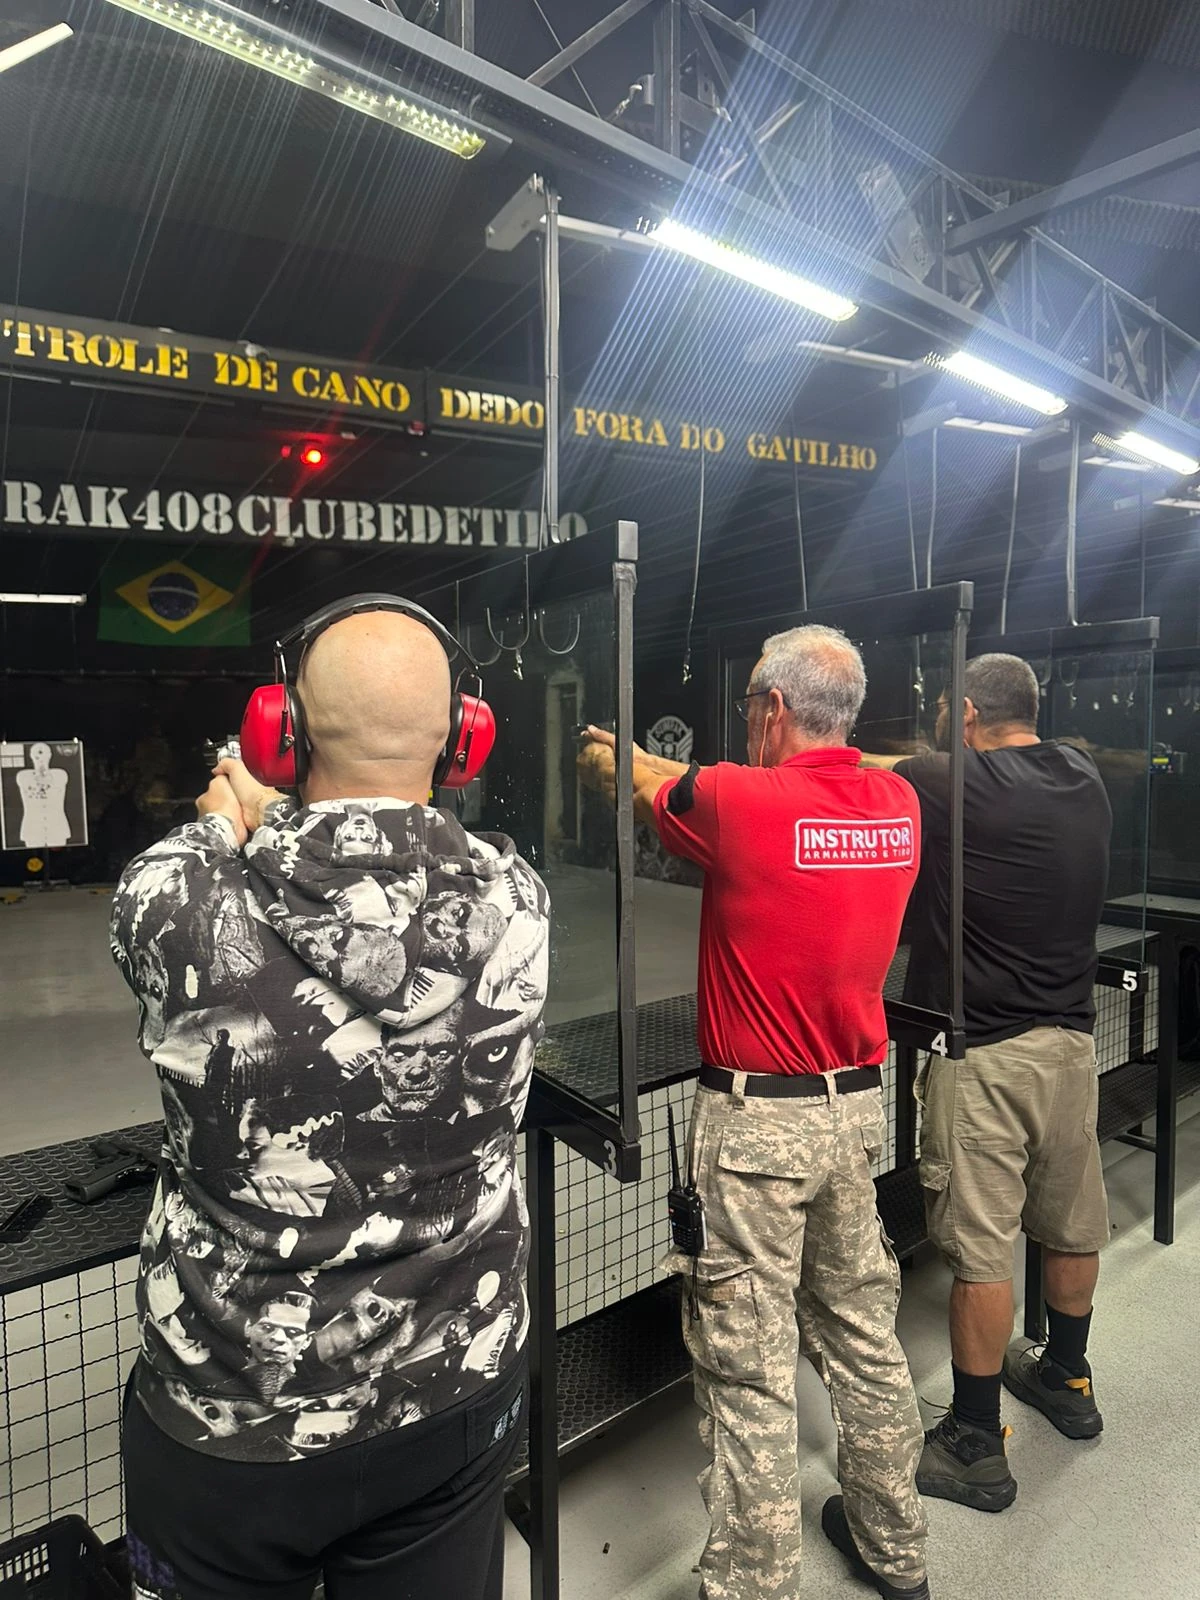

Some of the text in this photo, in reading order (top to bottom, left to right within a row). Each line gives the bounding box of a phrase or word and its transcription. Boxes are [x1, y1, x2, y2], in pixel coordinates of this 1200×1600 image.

[213, 351, 280, 394] DE
[291, 367, 411, 414] CANO
[440, 387, 877, 471] DEDO FORA DO GATILHO
[803, 827, 911, 849] INSTRUTOR
[804, 850, 878, 860] ARMAMENTO
[882, 849, 889, 858] E
[1122, 969, 1138, 992] 5
[931, 1031, 948, 1057] 4
[603, 1139, 617, 1177] 3
